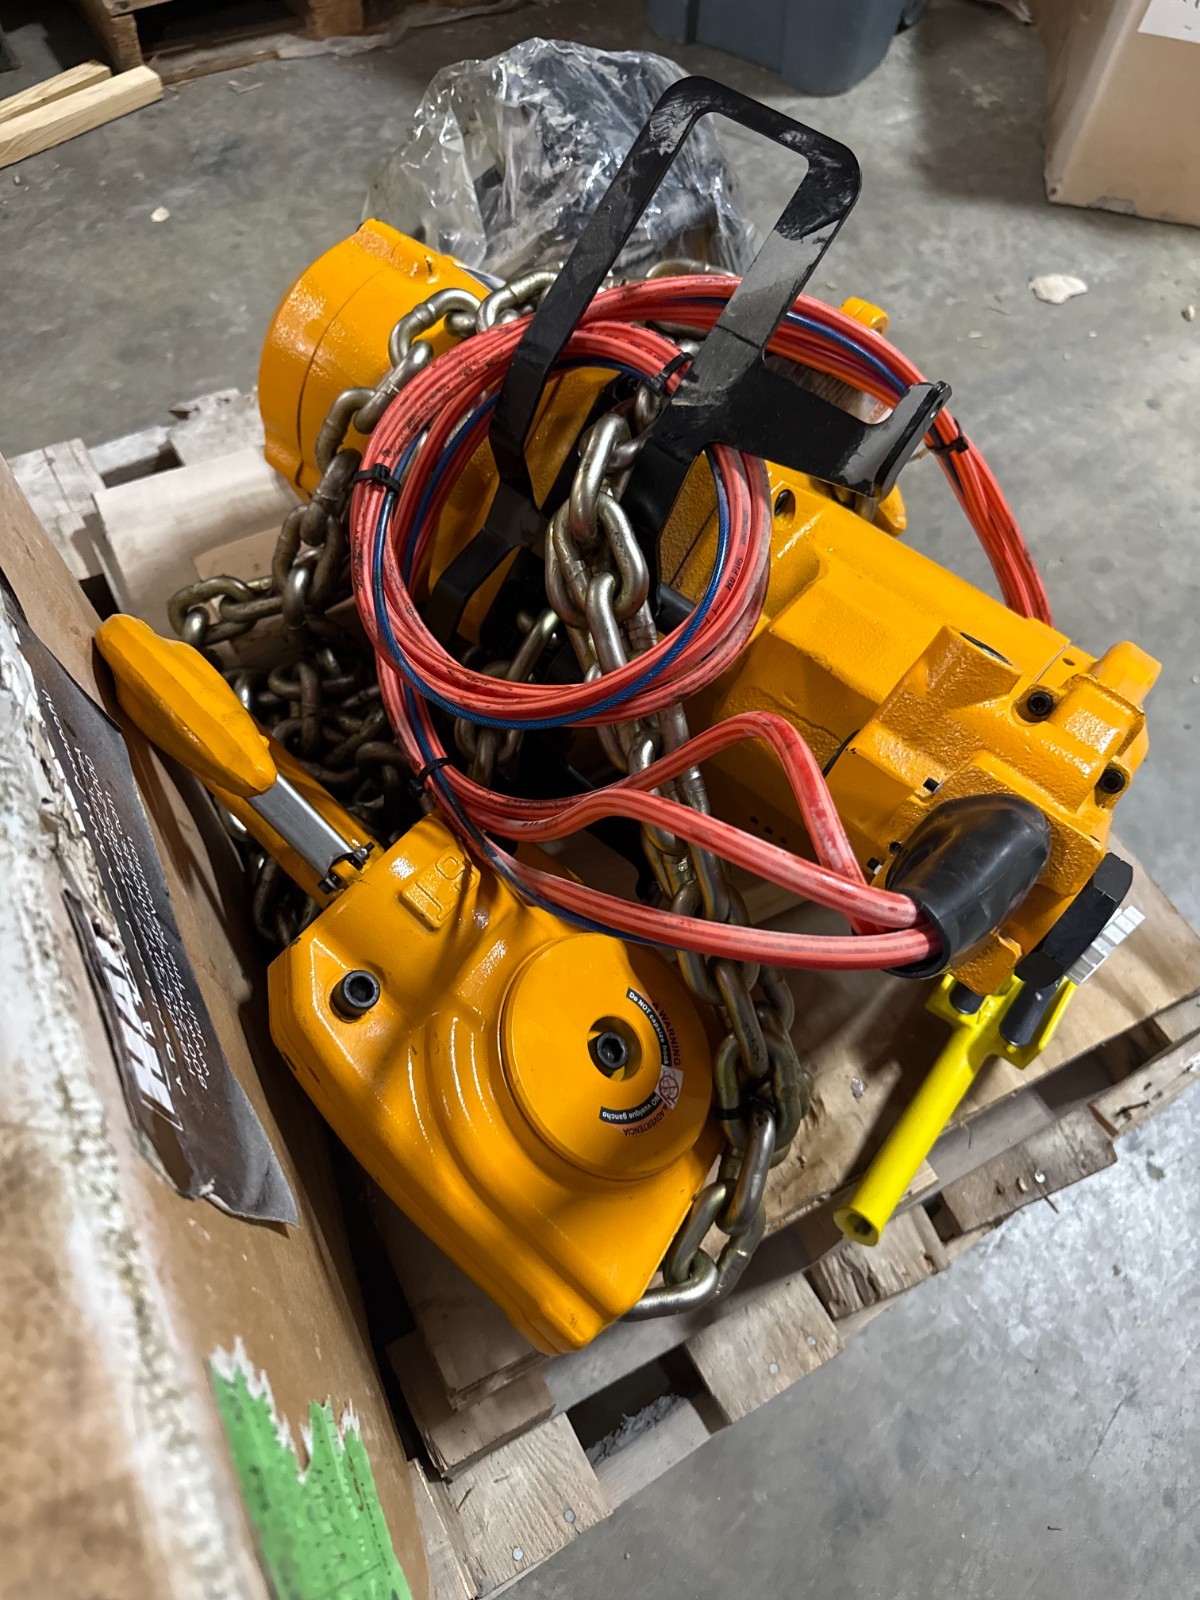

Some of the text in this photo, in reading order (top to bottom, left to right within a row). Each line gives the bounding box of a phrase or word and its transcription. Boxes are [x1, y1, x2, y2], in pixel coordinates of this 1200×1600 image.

[169, 952, 186, 990] The
[187, 1001, 207, 1048] Join
[628, 991, 671, 1066] Do NOT capsize hook
[659, 1010, 681, 1066] WARNING
[602, 1095, 661, 1121] NO vuelque gancho
[623, 1108, 664, 1136] ADVERTENCIA
